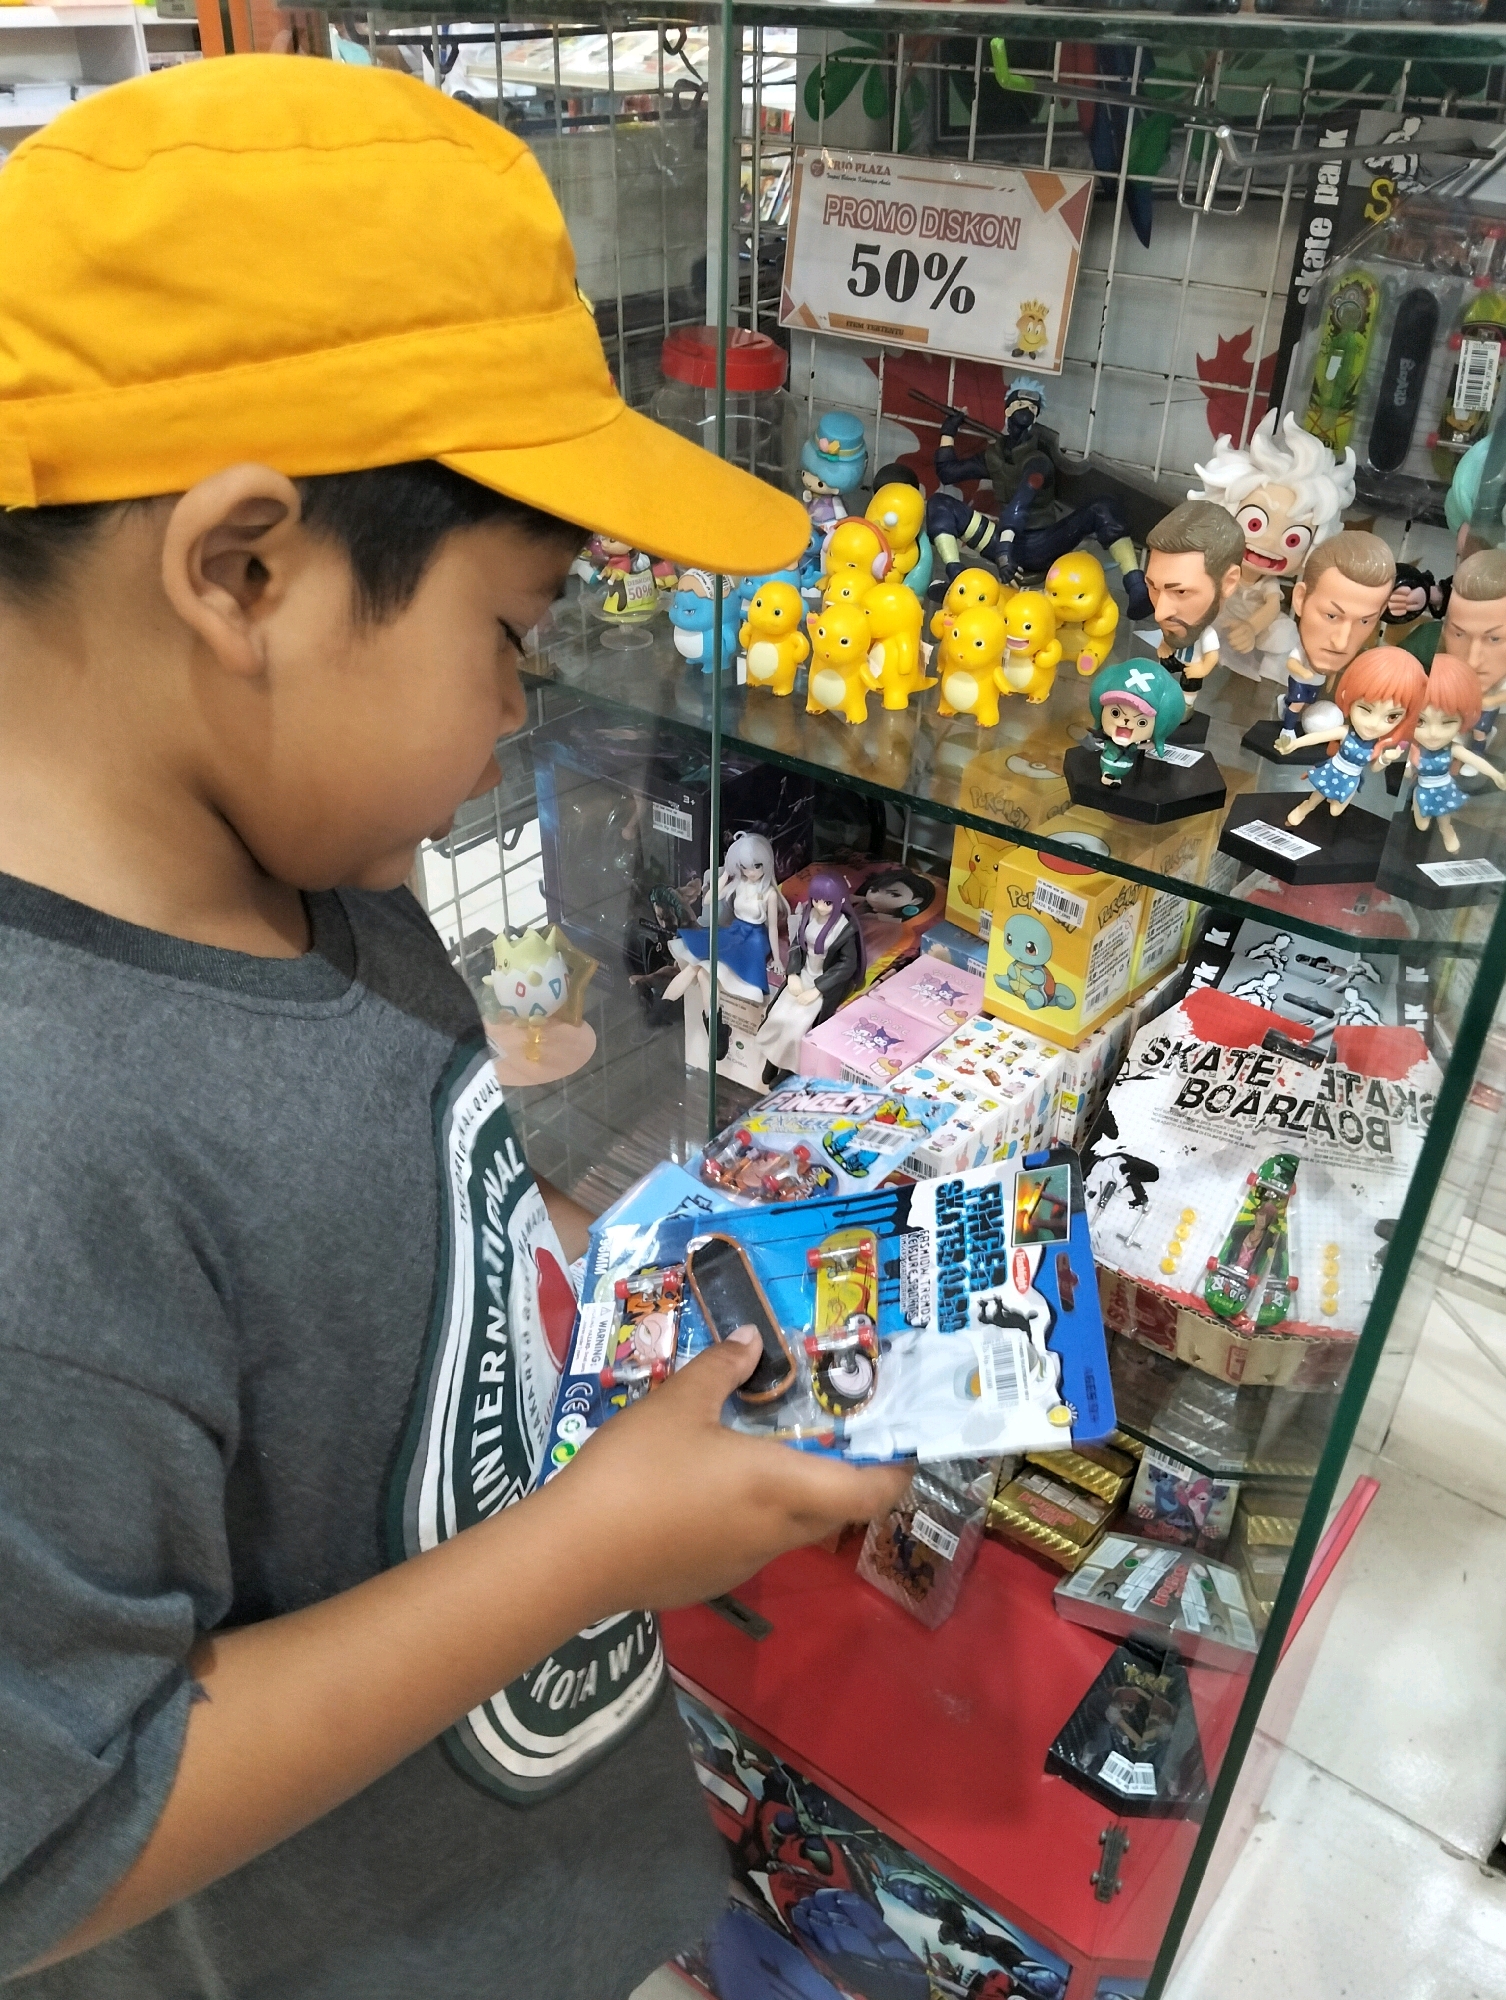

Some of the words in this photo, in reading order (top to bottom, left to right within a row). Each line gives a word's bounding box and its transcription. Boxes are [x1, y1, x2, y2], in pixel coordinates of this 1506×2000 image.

[855, 163, 891, 176] PLAZA
[823, 194, 917, 235] PROMO
[919, 206, 1021, 250] DISKON
[847, 243, 976, 314] 50%
[1294, 217, 1333, 305] skate
[628, 585, 654, 600] 50%
[1141, 1036, 1282, 1088] SKATE
[454, 1107, 475, 1181] ORIGNAL
[473, 1075, 500, 1112] QUAL
[754, 1090, 882, 1115] FINGER
[594, 1239, 611, 1276] 96MM
[935, 1177, 971, 1333] SKATEBOARD
[965, 1180, 1008, 1293] FINGER
[470, 1136, 526, 1503] INTERNATIONAL
[590, 1319, 608, 1371] WARNING:
[523, 1656, 599, 1711] KOTA
